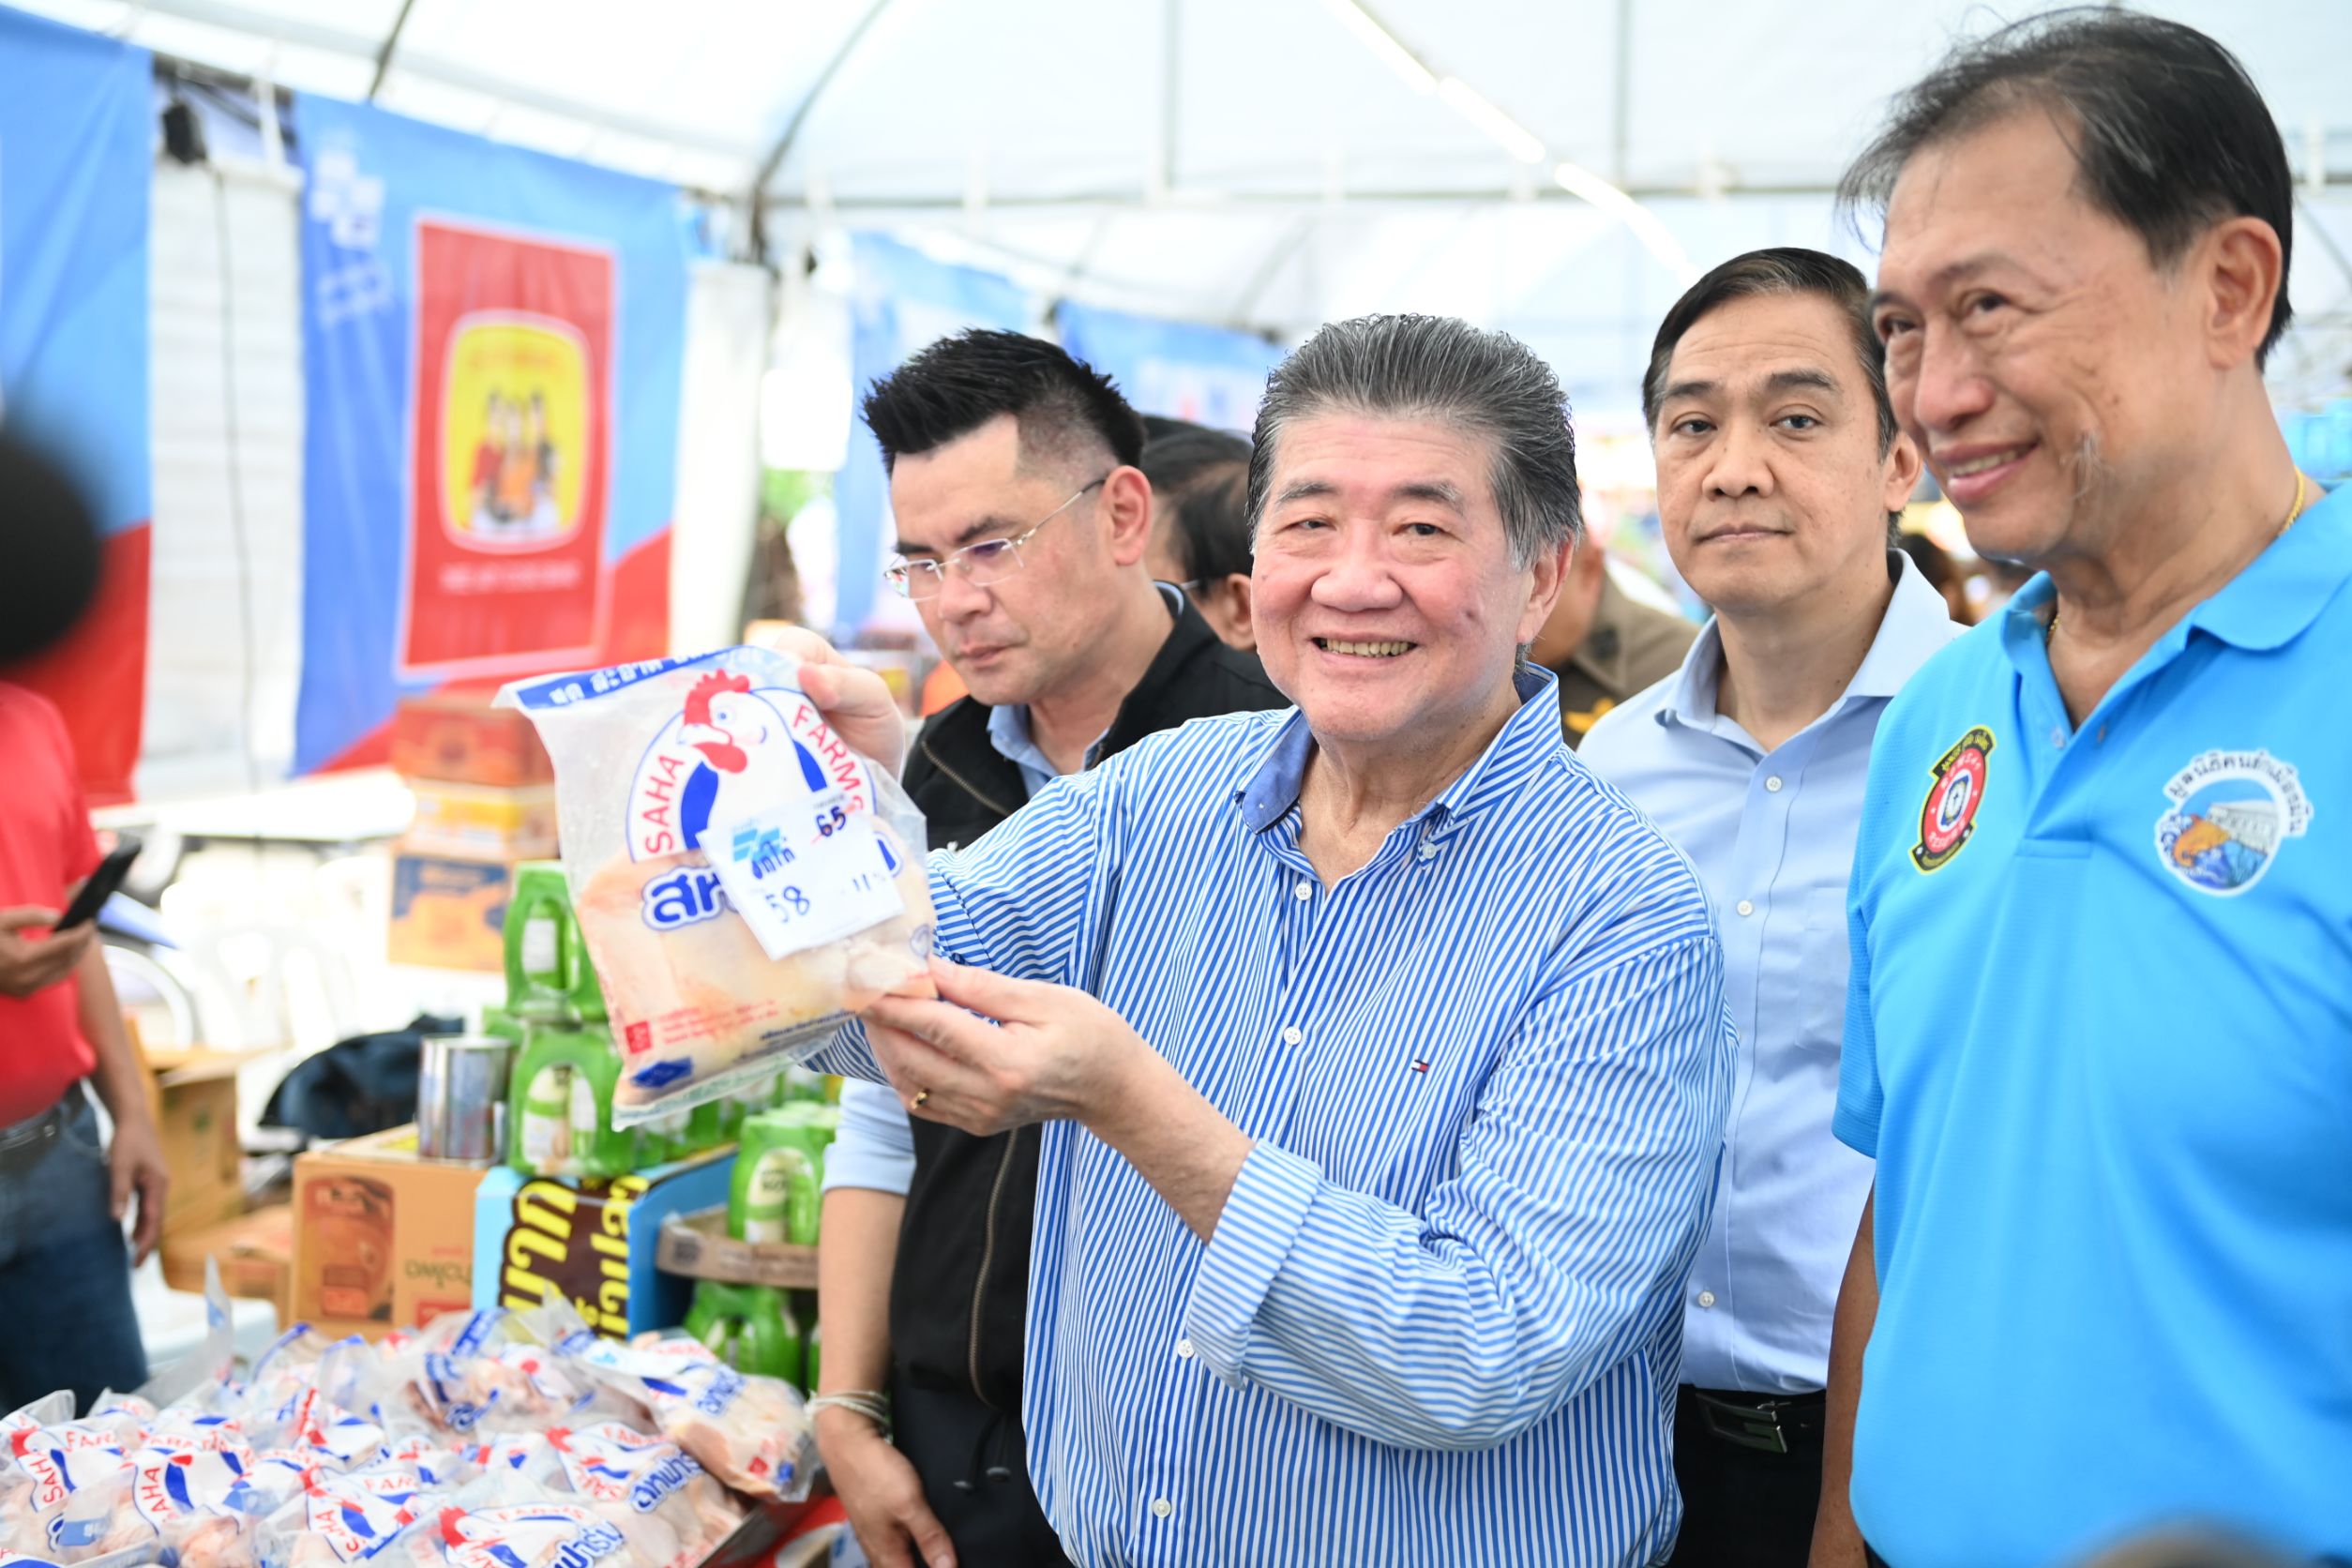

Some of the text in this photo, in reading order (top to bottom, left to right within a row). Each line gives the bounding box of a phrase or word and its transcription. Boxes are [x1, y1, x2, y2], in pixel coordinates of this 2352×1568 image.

[644, 753, 686, 855] SAHA
[815, 806, 848, 838] 65
[764, 885, 810, 924] 58
[30, 1452, 65, 1503] SAH
